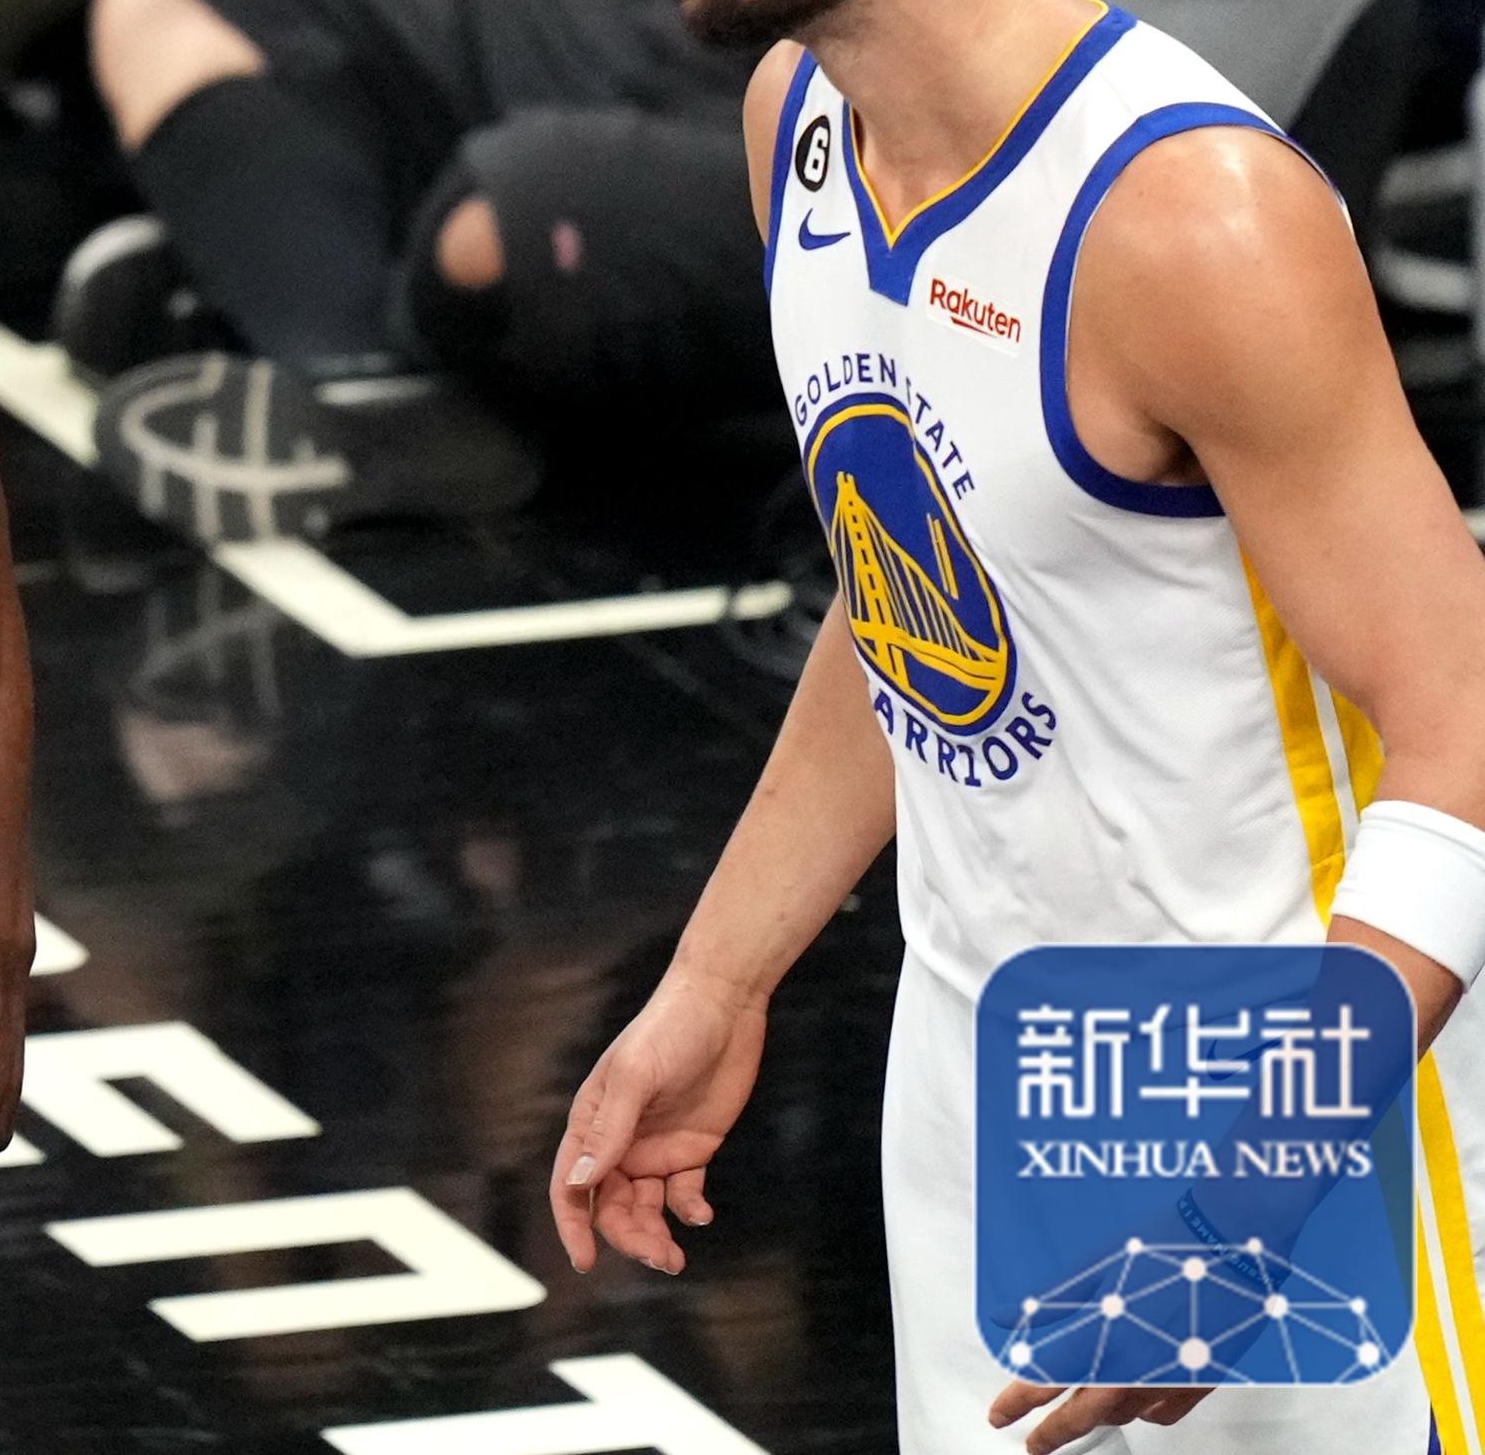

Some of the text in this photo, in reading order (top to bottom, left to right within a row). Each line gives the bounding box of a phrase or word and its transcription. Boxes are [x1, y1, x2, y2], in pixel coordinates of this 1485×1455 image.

[803, 125, 829, 183] 6
[929, 277, 1021, 343] Rakuten
[794, 352, 897, 427] GOLDEN
[873, 688, 1058, 787] ARRIORS
